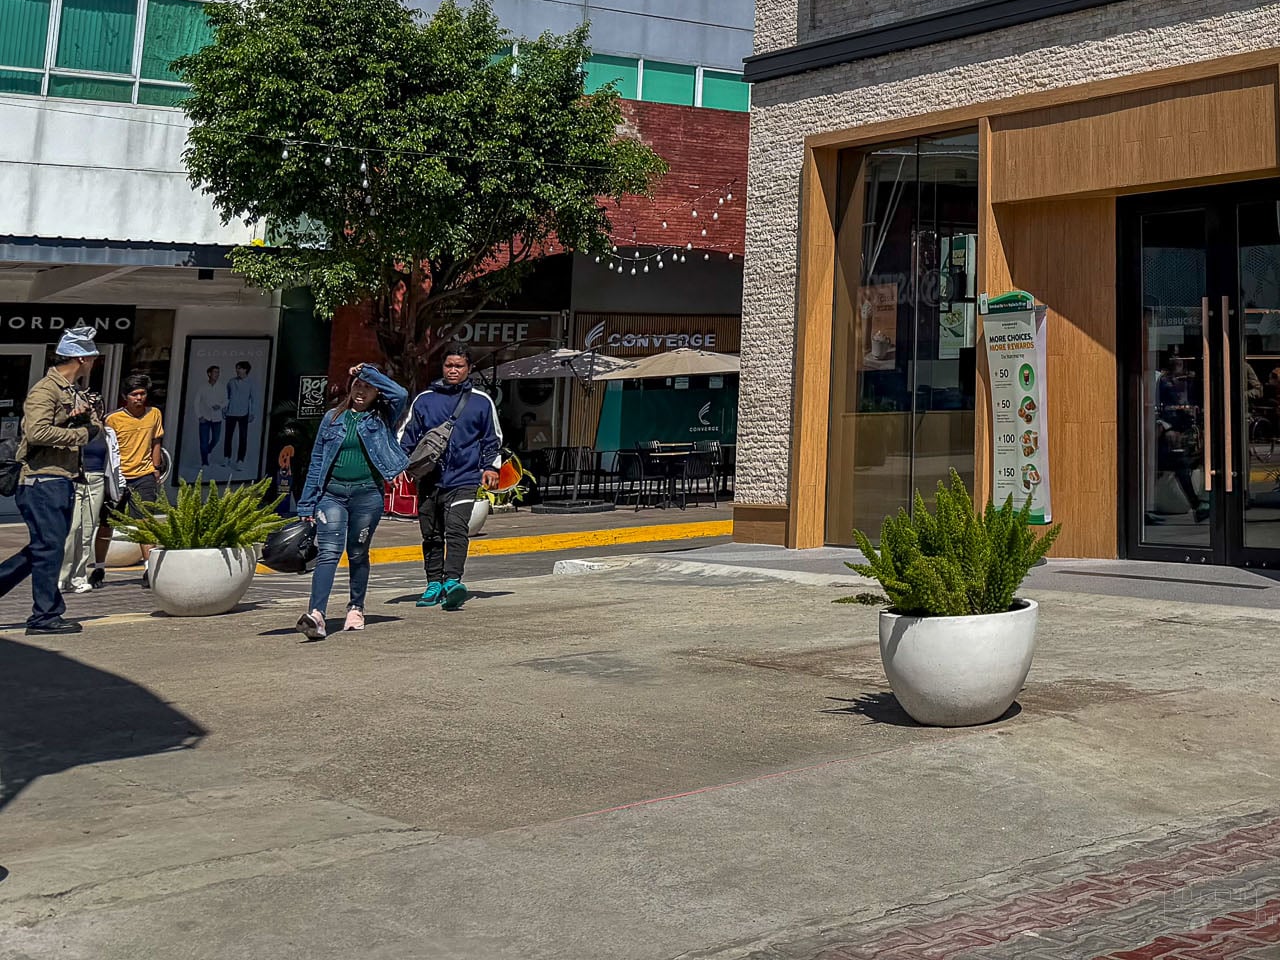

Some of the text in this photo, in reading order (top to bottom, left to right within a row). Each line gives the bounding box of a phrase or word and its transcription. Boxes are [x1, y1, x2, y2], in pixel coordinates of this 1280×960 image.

[607, 333, 716, 347] CONVERGE
[989, 335, 1006, 343] MORE
[990, 342, 1034, 351] MORE REWARDS
[1000, 369, 1008, 378] 50
[1002, 400, 1010, 408] 50
[1003, 434, 1015, 443] 100
[1003, 468, 1015, 477] 150
